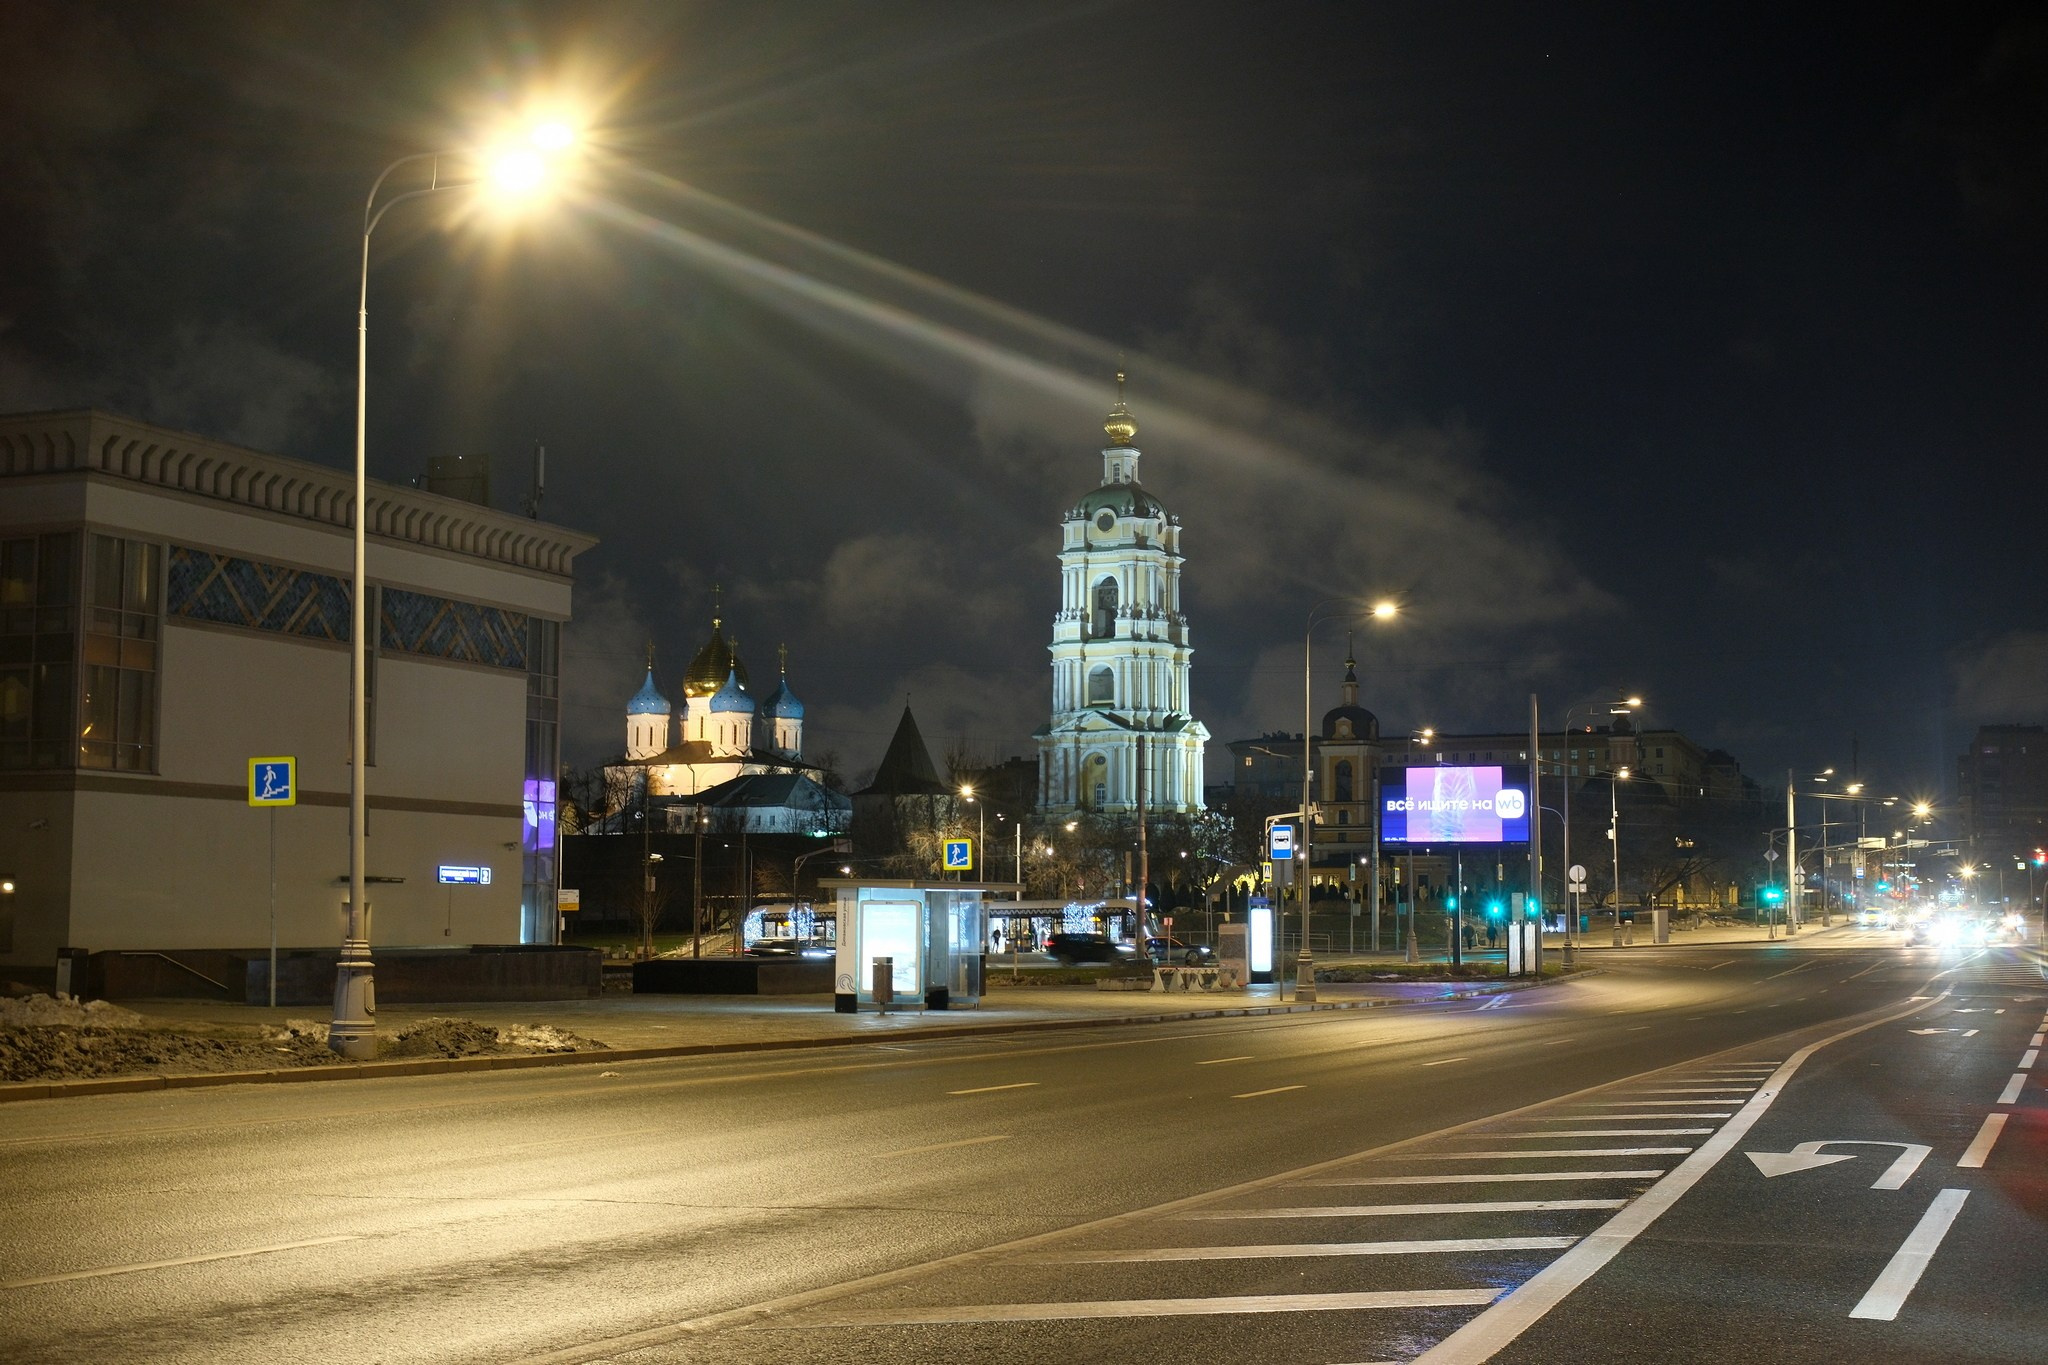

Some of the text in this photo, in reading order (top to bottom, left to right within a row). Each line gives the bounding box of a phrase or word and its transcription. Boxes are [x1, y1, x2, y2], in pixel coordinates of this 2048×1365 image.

[1387, 798, 1493, 811] всё ищите на
[1498, 795, 1522, 809] wb
